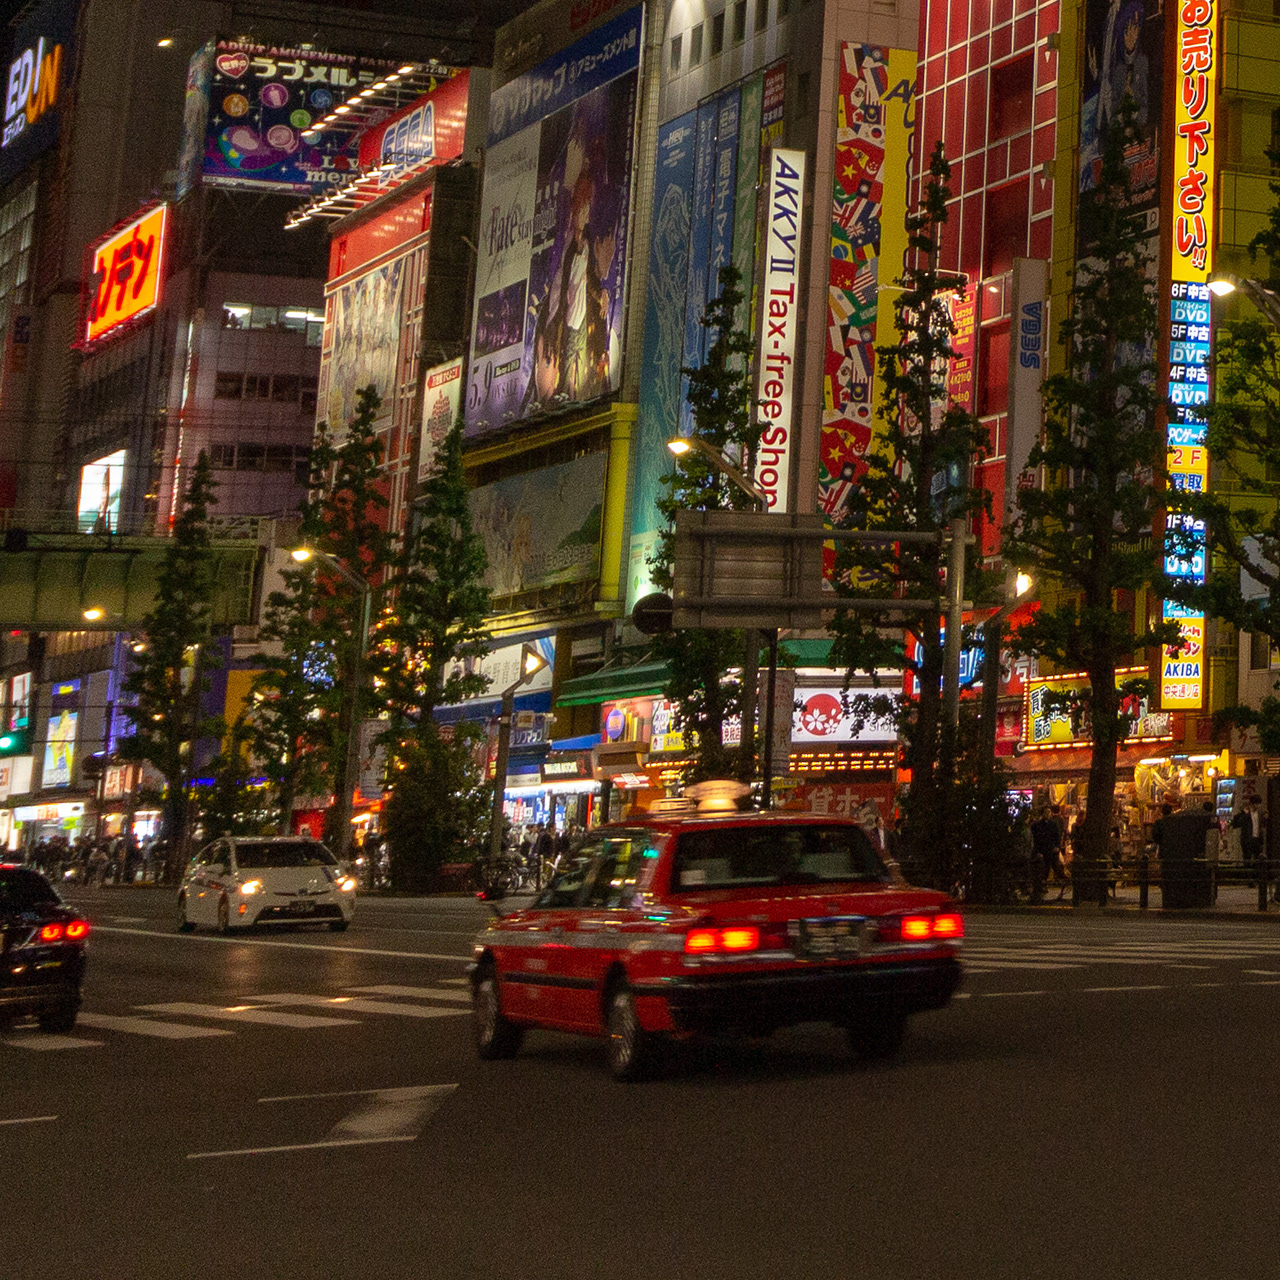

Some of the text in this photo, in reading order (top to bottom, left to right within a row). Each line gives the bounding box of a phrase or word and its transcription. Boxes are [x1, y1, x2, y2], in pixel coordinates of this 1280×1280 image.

[770, 154, 800, 255] AKKY
[1171, 281, 1210, 300] 6F 中古
[1175, 308, 1208, 323] DVD
[1020, 300, 1043, 370] SEGA
[1171, 323, 1210, 341] 5F 中古
[763, 282, 796, 420] Tax-free
[1172, 349, 1207, 365] DVD
[1169, 364, 1208, 383] 4F 中古
[1169, 472, 1203, 491] 買取
[1163, 662, 1200, 678] AKIBA
[1162, 683, 1200, 700] 中央通り店
